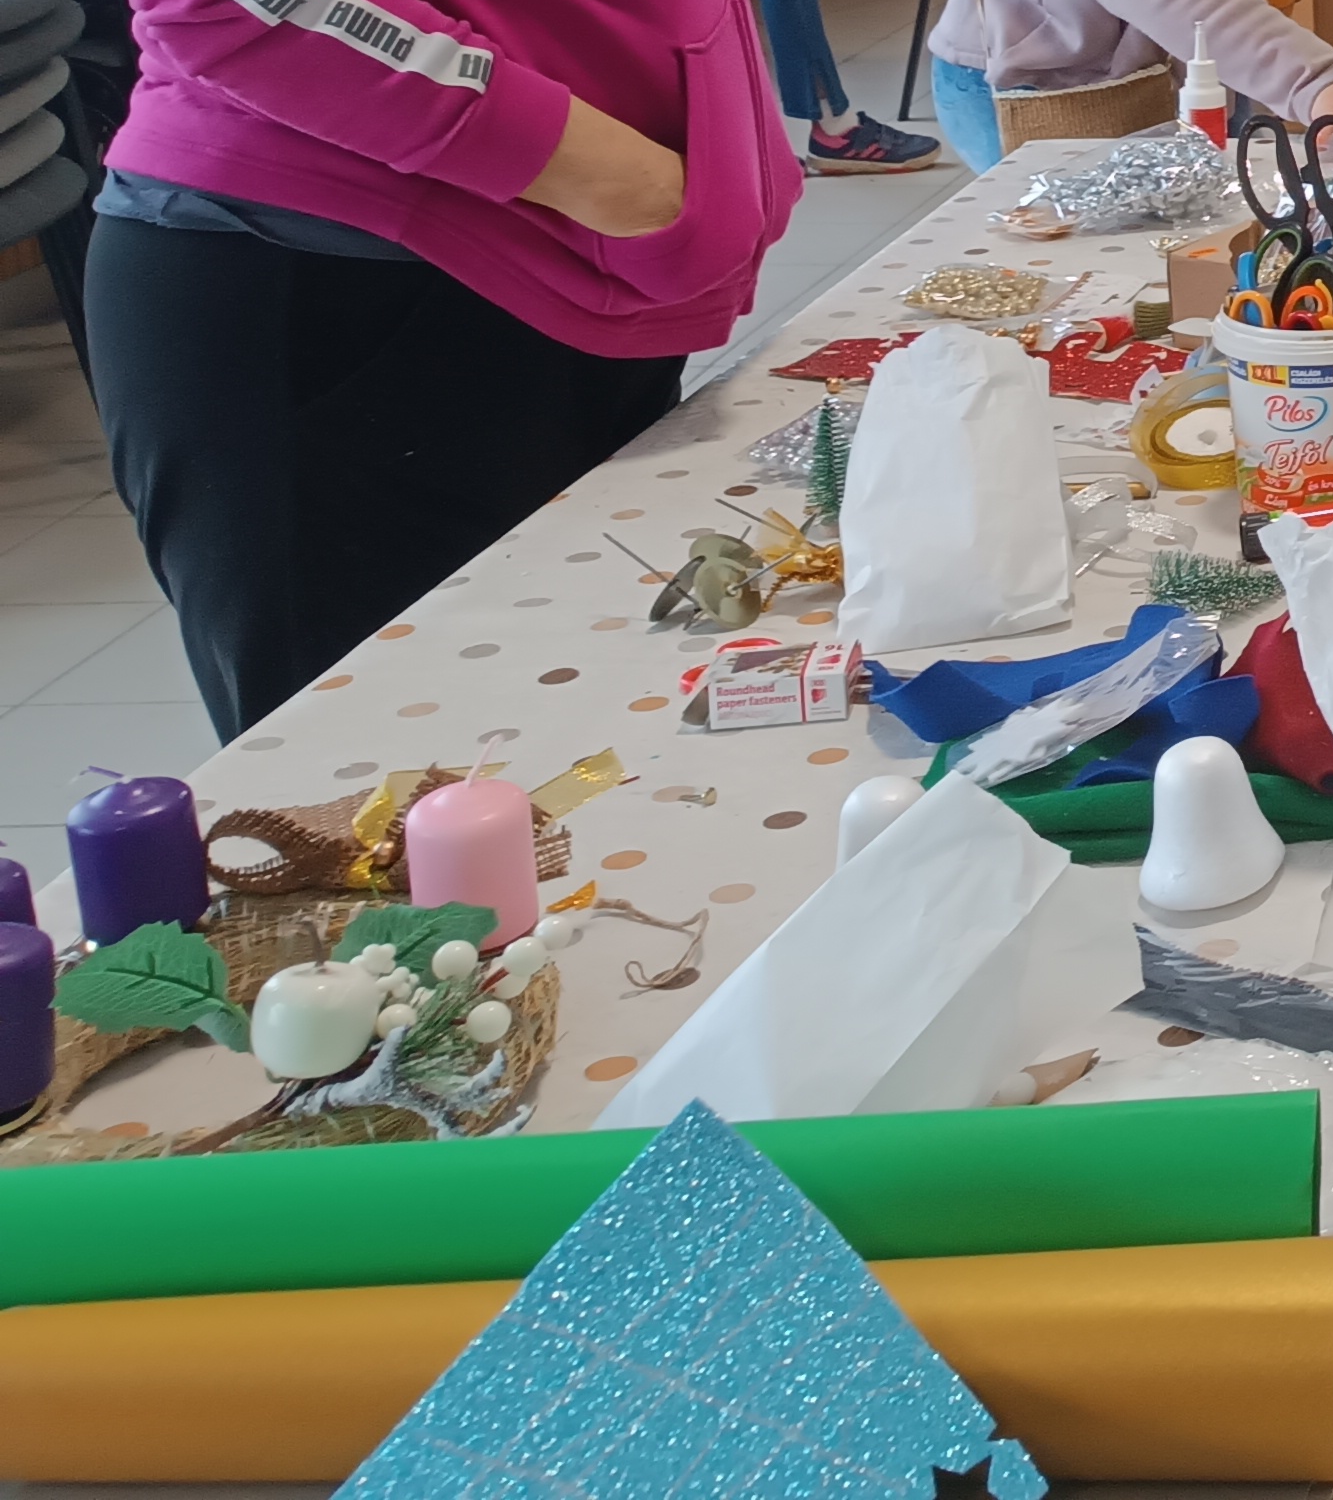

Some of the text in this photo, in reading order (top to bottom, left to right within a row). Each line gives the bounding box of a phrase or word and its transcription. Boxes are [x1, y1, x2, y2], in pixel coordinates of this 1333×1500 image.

[325, 0, 415, 62] PUMA
[1252, 365, 1286, 386] XXL
[1264, 395, 1315, 423] Pilos
[716, 682, 776, 697] Roundhead
[716, 694, 798, 711] paper fasteners
